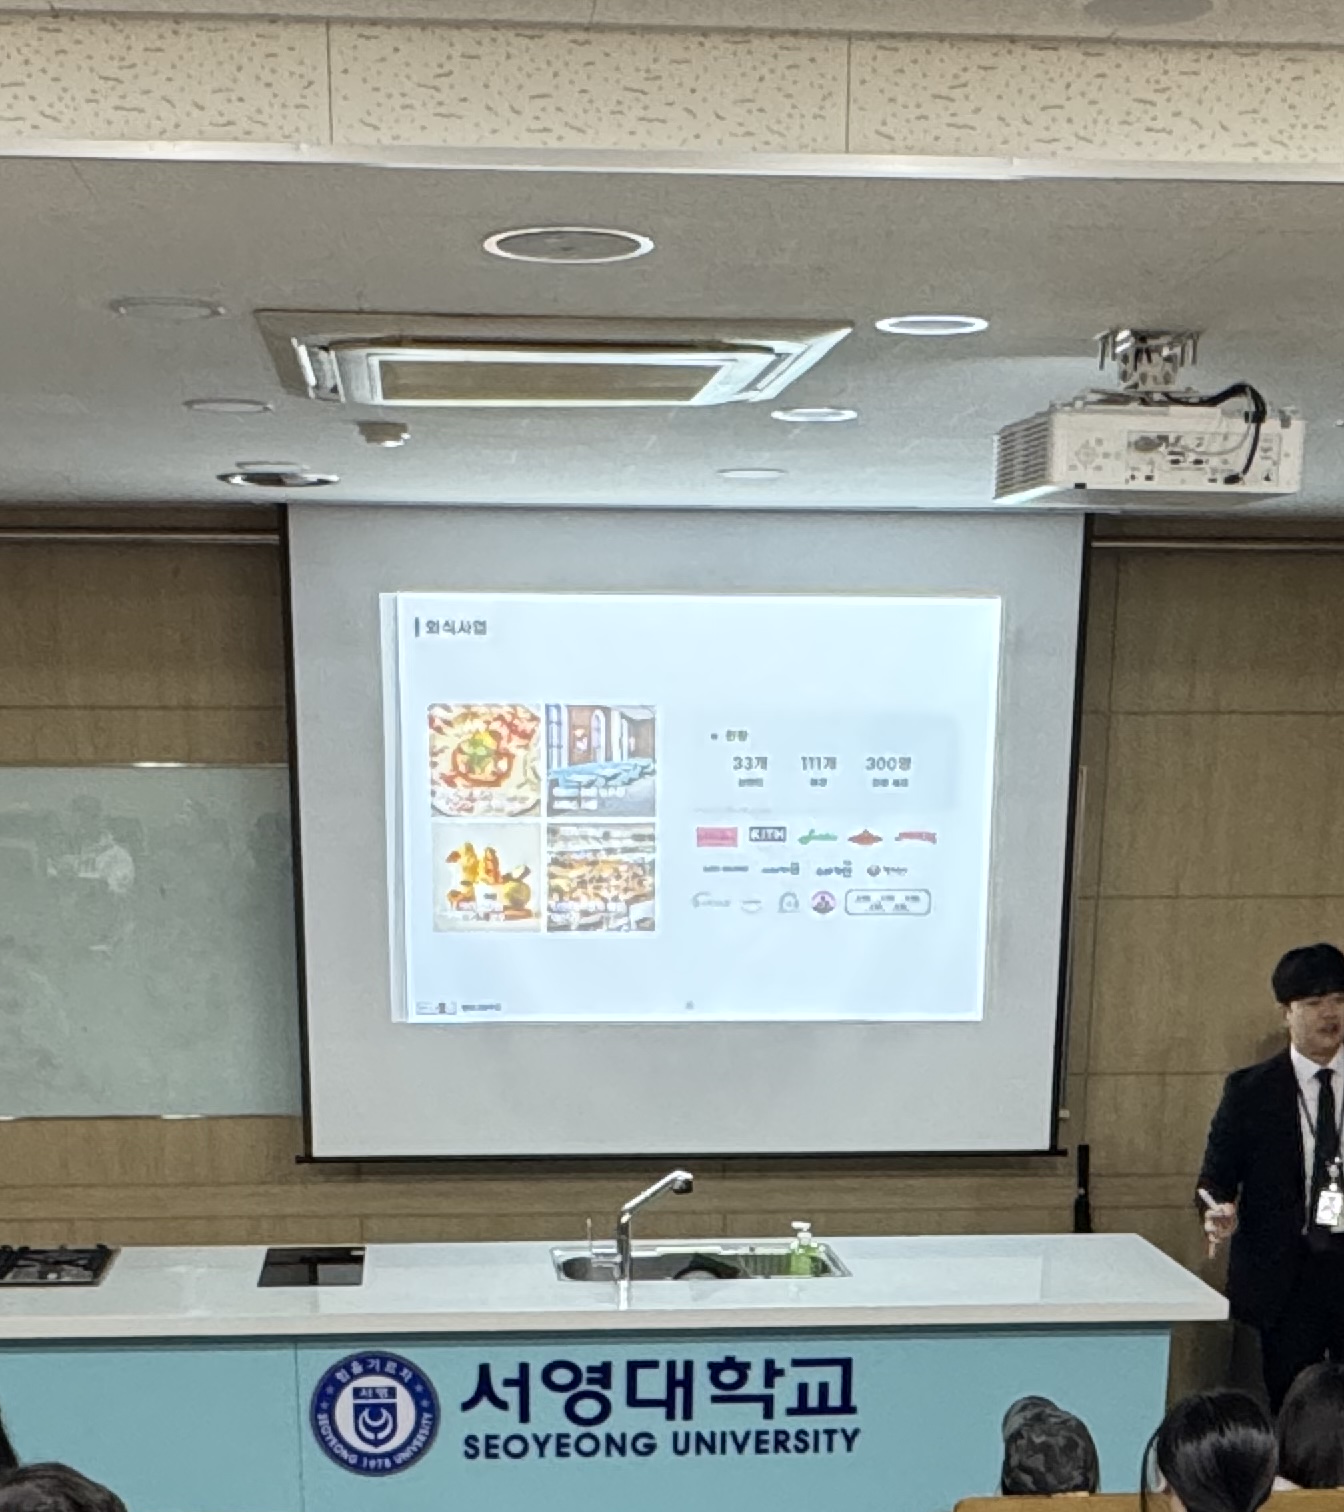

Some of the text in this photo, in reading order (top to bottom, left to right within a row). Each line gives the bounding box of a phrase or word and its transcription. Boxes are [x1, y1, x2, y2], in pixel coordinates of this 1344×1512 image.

[425, 619, 488, 636] 외식사업
[732, 756, 768, 771] 33개
[800, 756, 837, 771] 111개
[460, 1355, 859, 1427] 서영대학교
[463, 1426, 861, 1461] SEOYEONG UNIVERSITY
